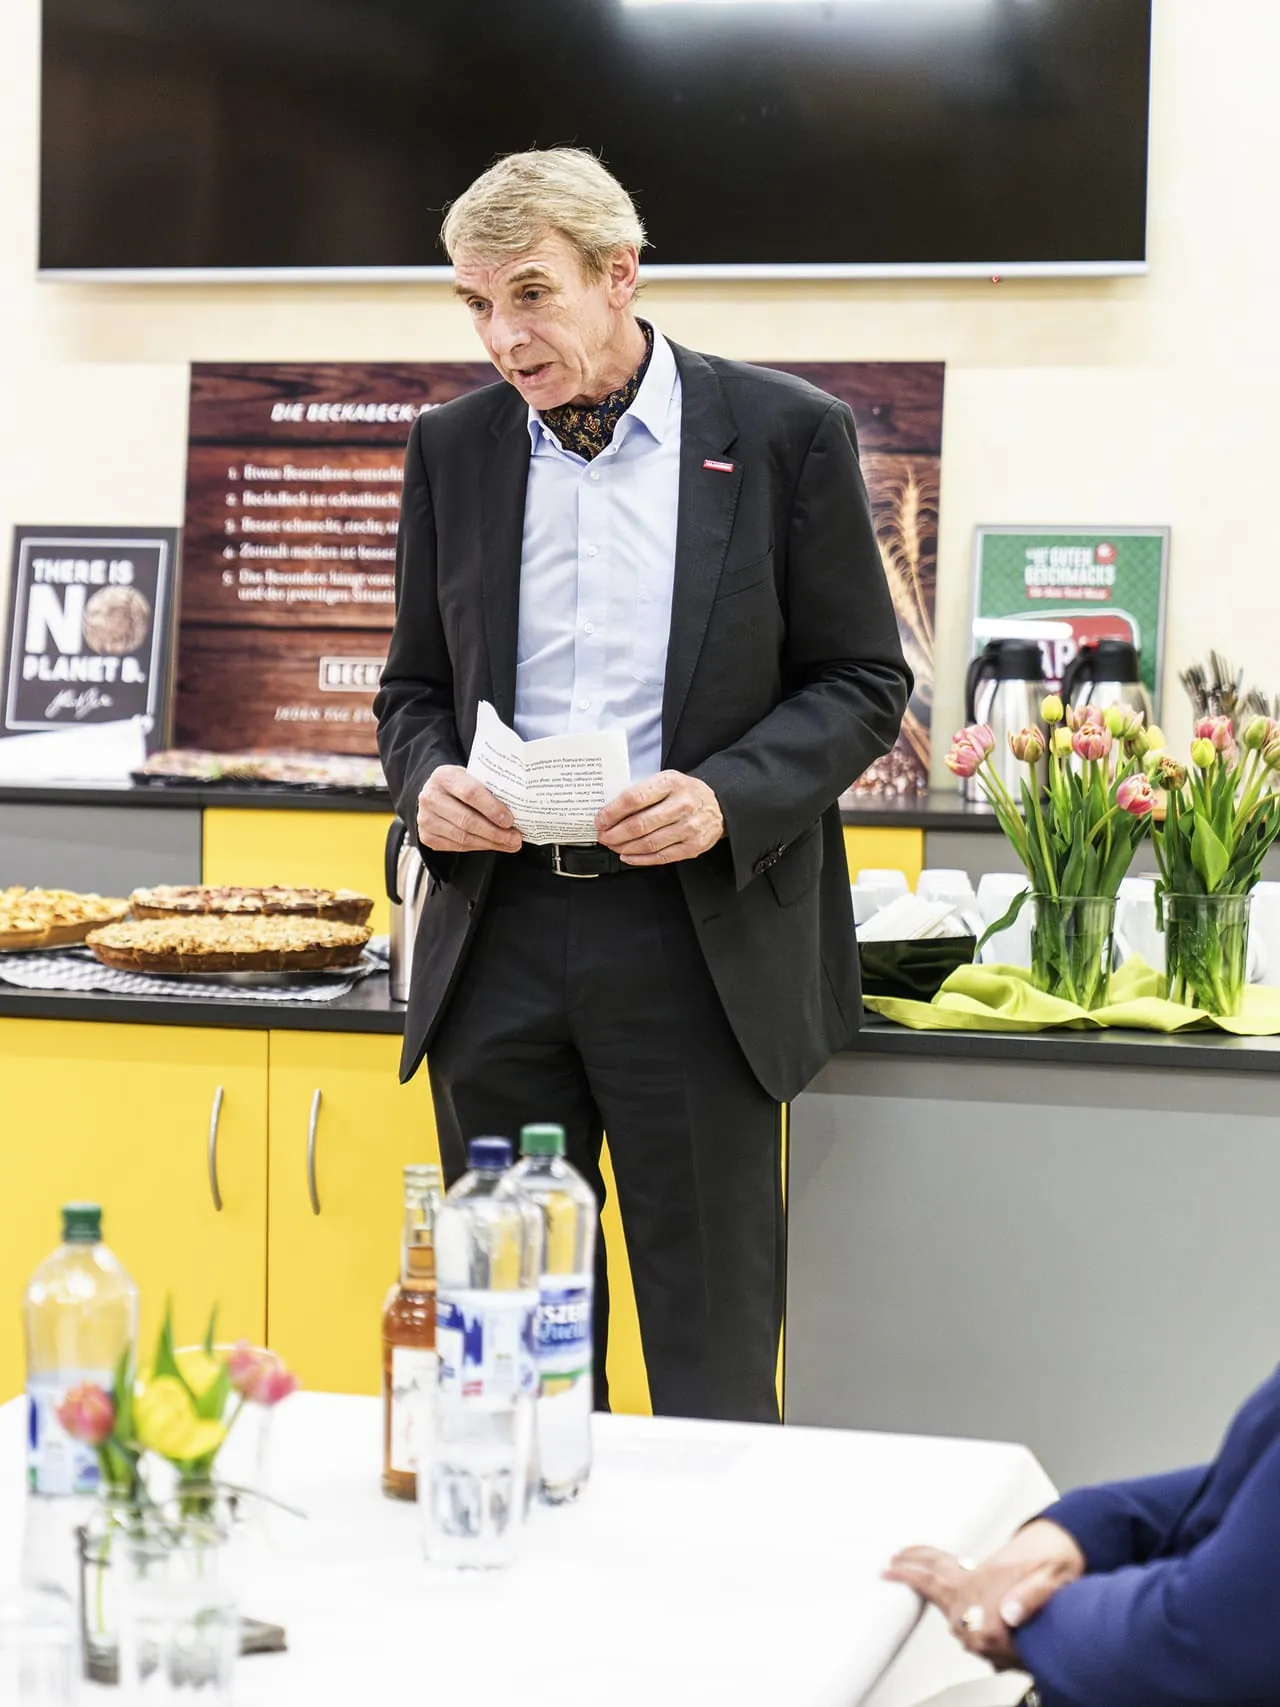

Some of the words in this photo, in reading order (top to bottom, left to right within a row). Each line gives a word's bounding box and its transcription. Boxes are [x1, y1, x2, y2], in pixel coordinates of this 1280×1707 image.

[270, 402, 306, 422] DIE
[243, 464, 282, 481] Etwas
[282, 464, 352, 481] Besonderes
[241, 516, 280, 533] Besser
[32, 558, 107, 584] THERE
[108, 560, 135, 585] IS
[22, 655, 121, 682] PLANET
